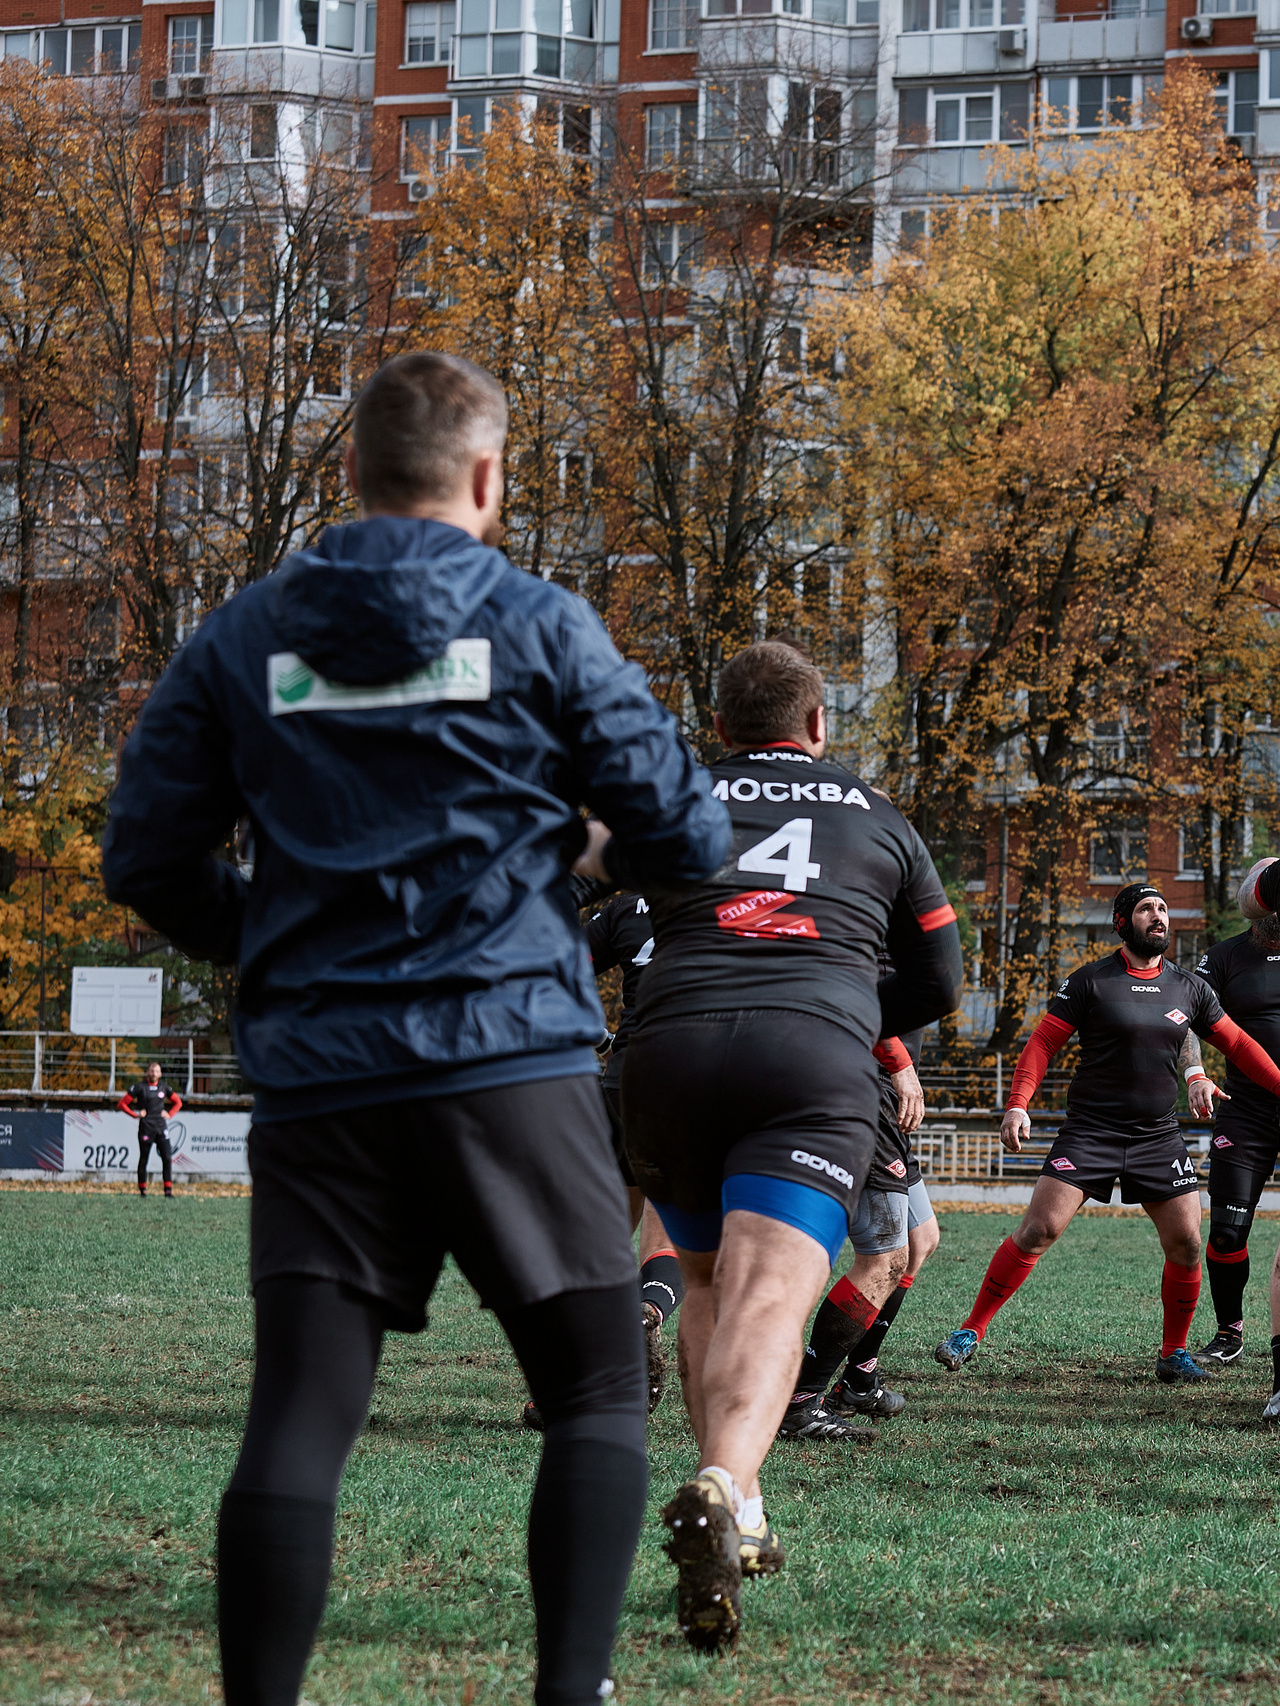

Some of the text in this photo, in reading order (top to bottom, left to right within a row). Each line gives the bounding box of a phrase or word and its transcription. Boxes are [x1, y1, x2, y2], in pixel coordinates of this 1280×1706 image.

[737, 818, 821, 892] 4
[83, 1145, 129, 1169] 2022
[1171, 1156, 1195, 1177] 14
